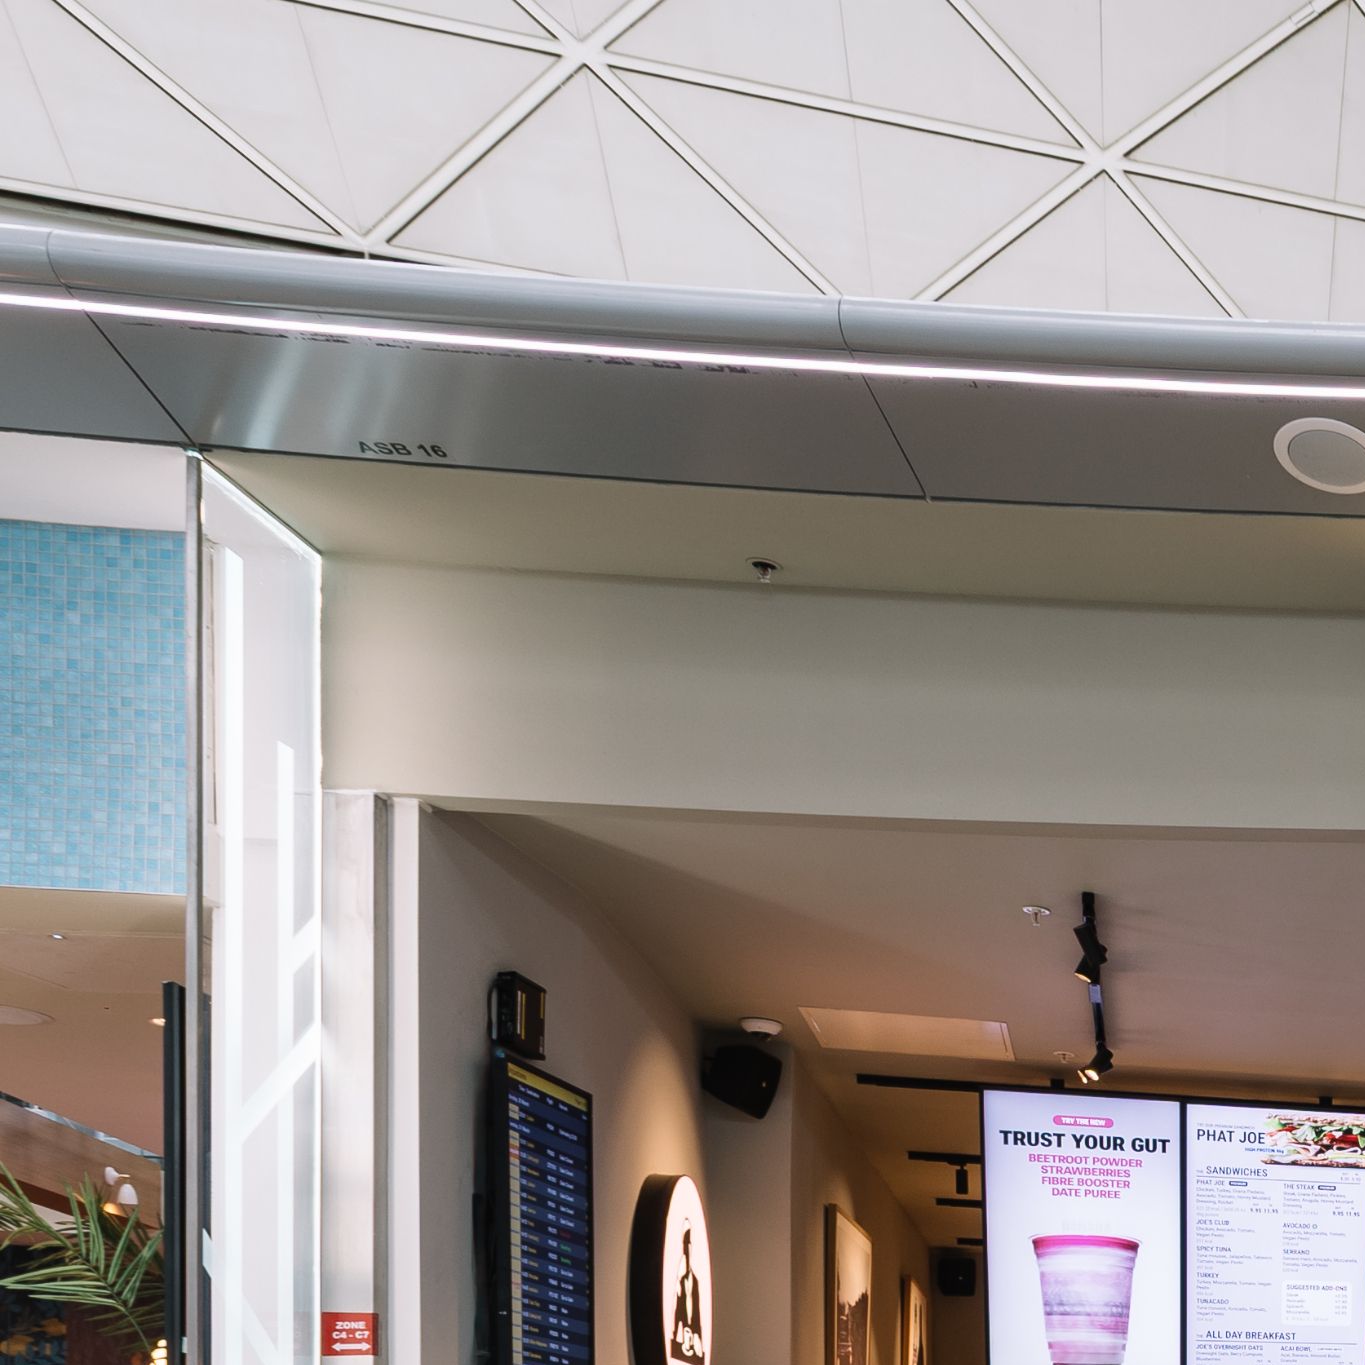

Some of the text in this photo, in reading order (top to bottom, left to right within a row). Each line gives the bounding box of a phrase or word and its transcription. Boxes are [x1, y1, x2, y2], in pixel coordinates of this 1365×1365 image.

[358, 440, 448, 458] ASB 16
[999, 1130, 1171, 1154] TRUST YOUR GUT
[1196, 1128, 1266, 1145] PHAT JOE
[1028, 1153, 1143, 1168] BEETROOT POWDER
[1040, 1165, 1131, 1178] STRAWBERRIES
[1206, 1166, 1268, 1177] SANDWICHES
[1041, 1176, 1131, 1189] FIBRE BOOSTER
[1051, 1187, 1121, 1199] DATE PUREE
[335, 1321, 367, 1330] ZONE
[332, 1331, 348, 1339] C4
[354, 1331, 370, 1339] C7
[1205, 1330, 1297, 1341] ALL DAY BREAKFAST
